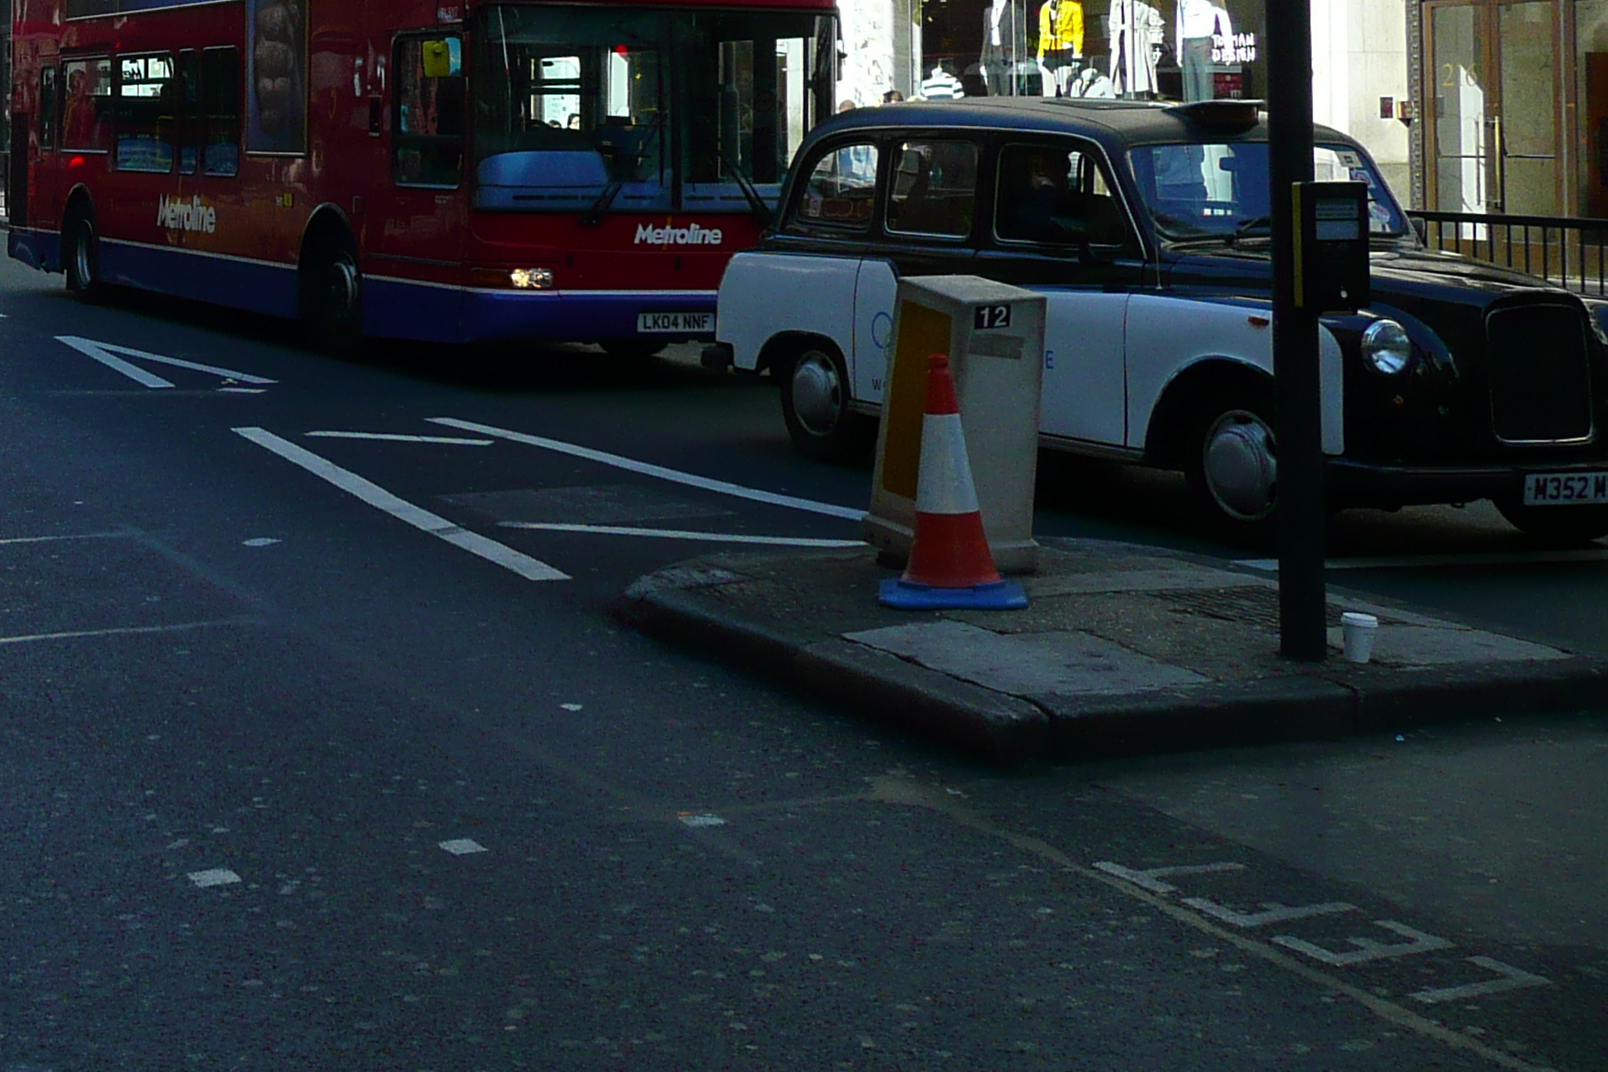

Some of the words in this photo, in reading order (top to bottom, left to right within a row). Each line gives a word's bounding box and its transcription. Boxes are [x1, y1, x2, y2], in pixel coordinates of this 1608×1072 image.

[156, 193, 216, 234] Metroline
[633, 222, 722, 245] Metroline
[643, 315, 679, 329] LK04
[683, 315, 710, 329] NNF
[980, 306, 1007, 327] 12
[1533, 476, 1589, 500] M352
